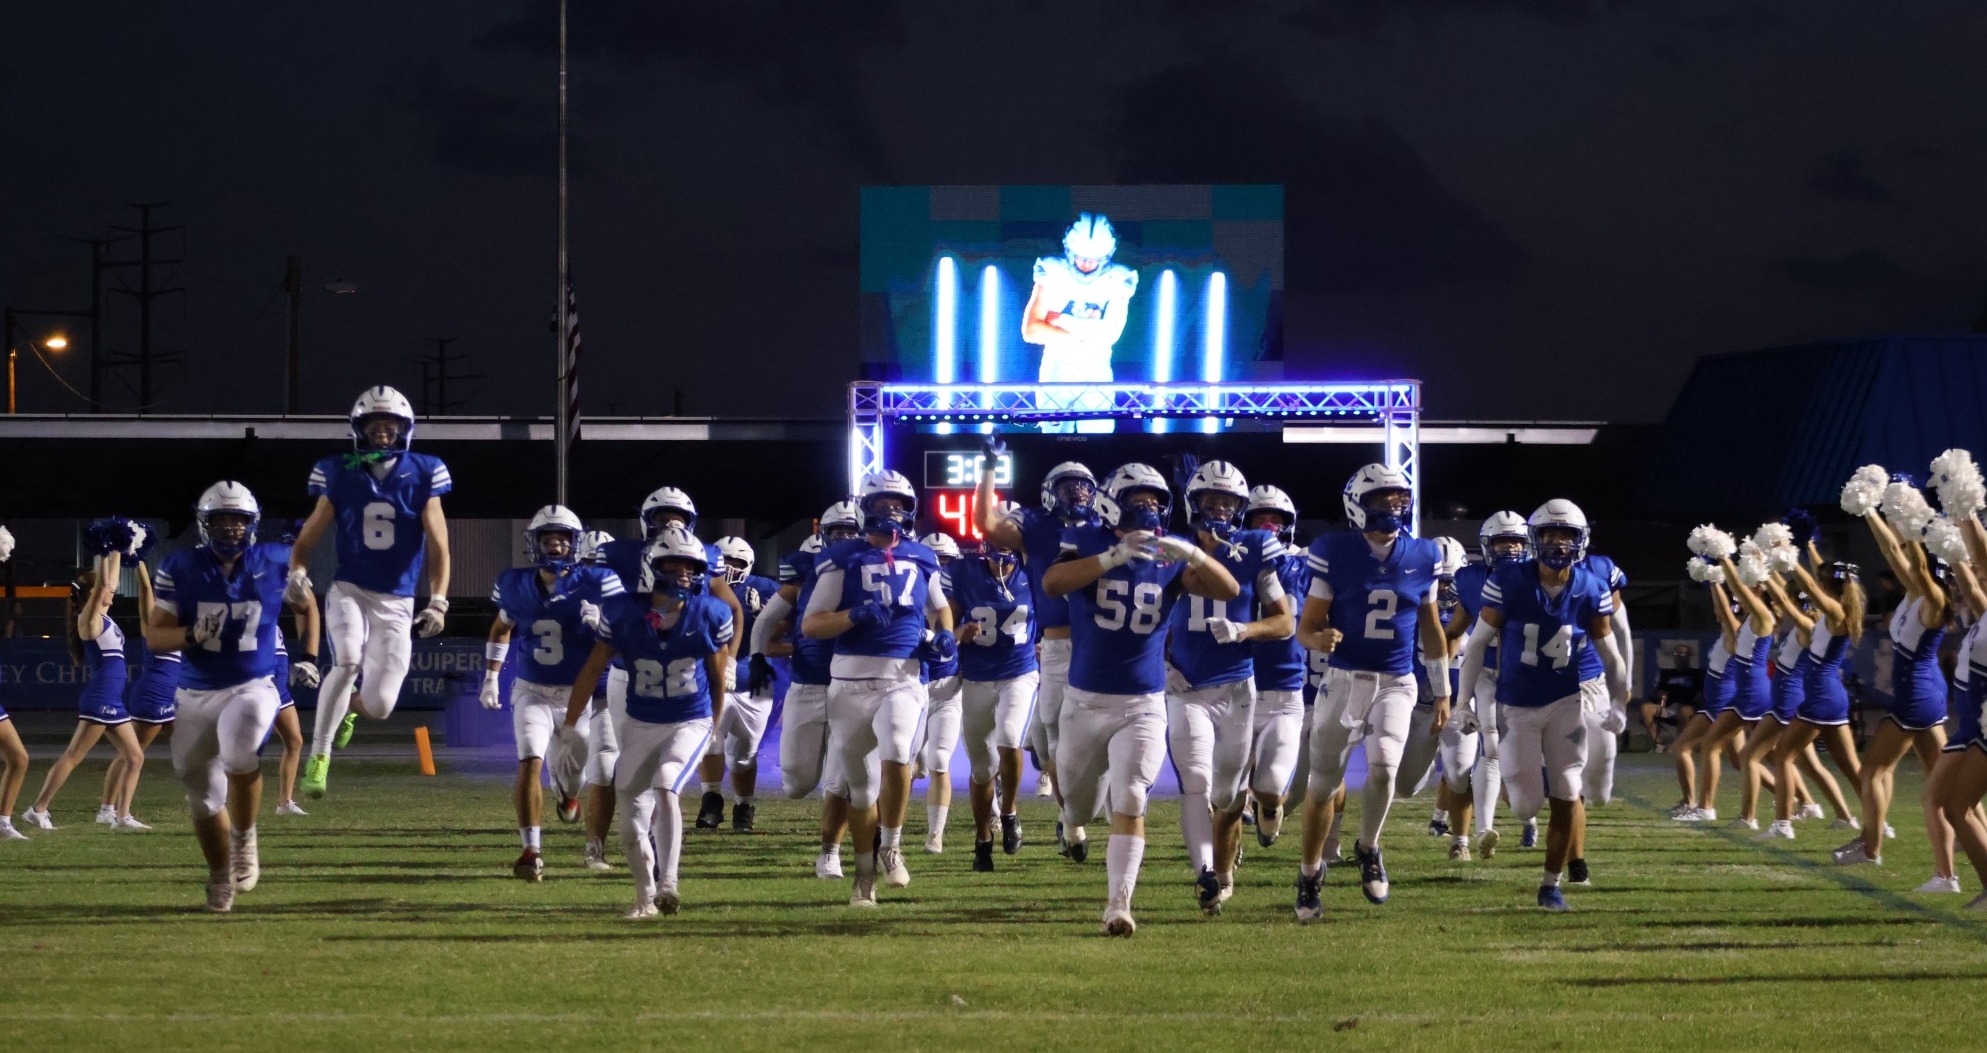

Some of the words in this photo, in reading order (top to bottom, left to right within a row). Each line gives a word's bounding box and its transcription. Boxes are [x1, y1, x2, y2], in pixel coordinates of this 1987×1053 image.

[363, 502, 396, 550] 6
[860, 560, 918, 607] 57
[1094, 578, 1163, 634] 58
[197, 600, 262, 652] 77
[970, 604, 1028, 647] 34
[1364, 589, 1398, 640] 2
[532, 619, 564, 665] 3
[1520, 623, 1572, 669] 14
[36, 661, 144, 684] CHRT
